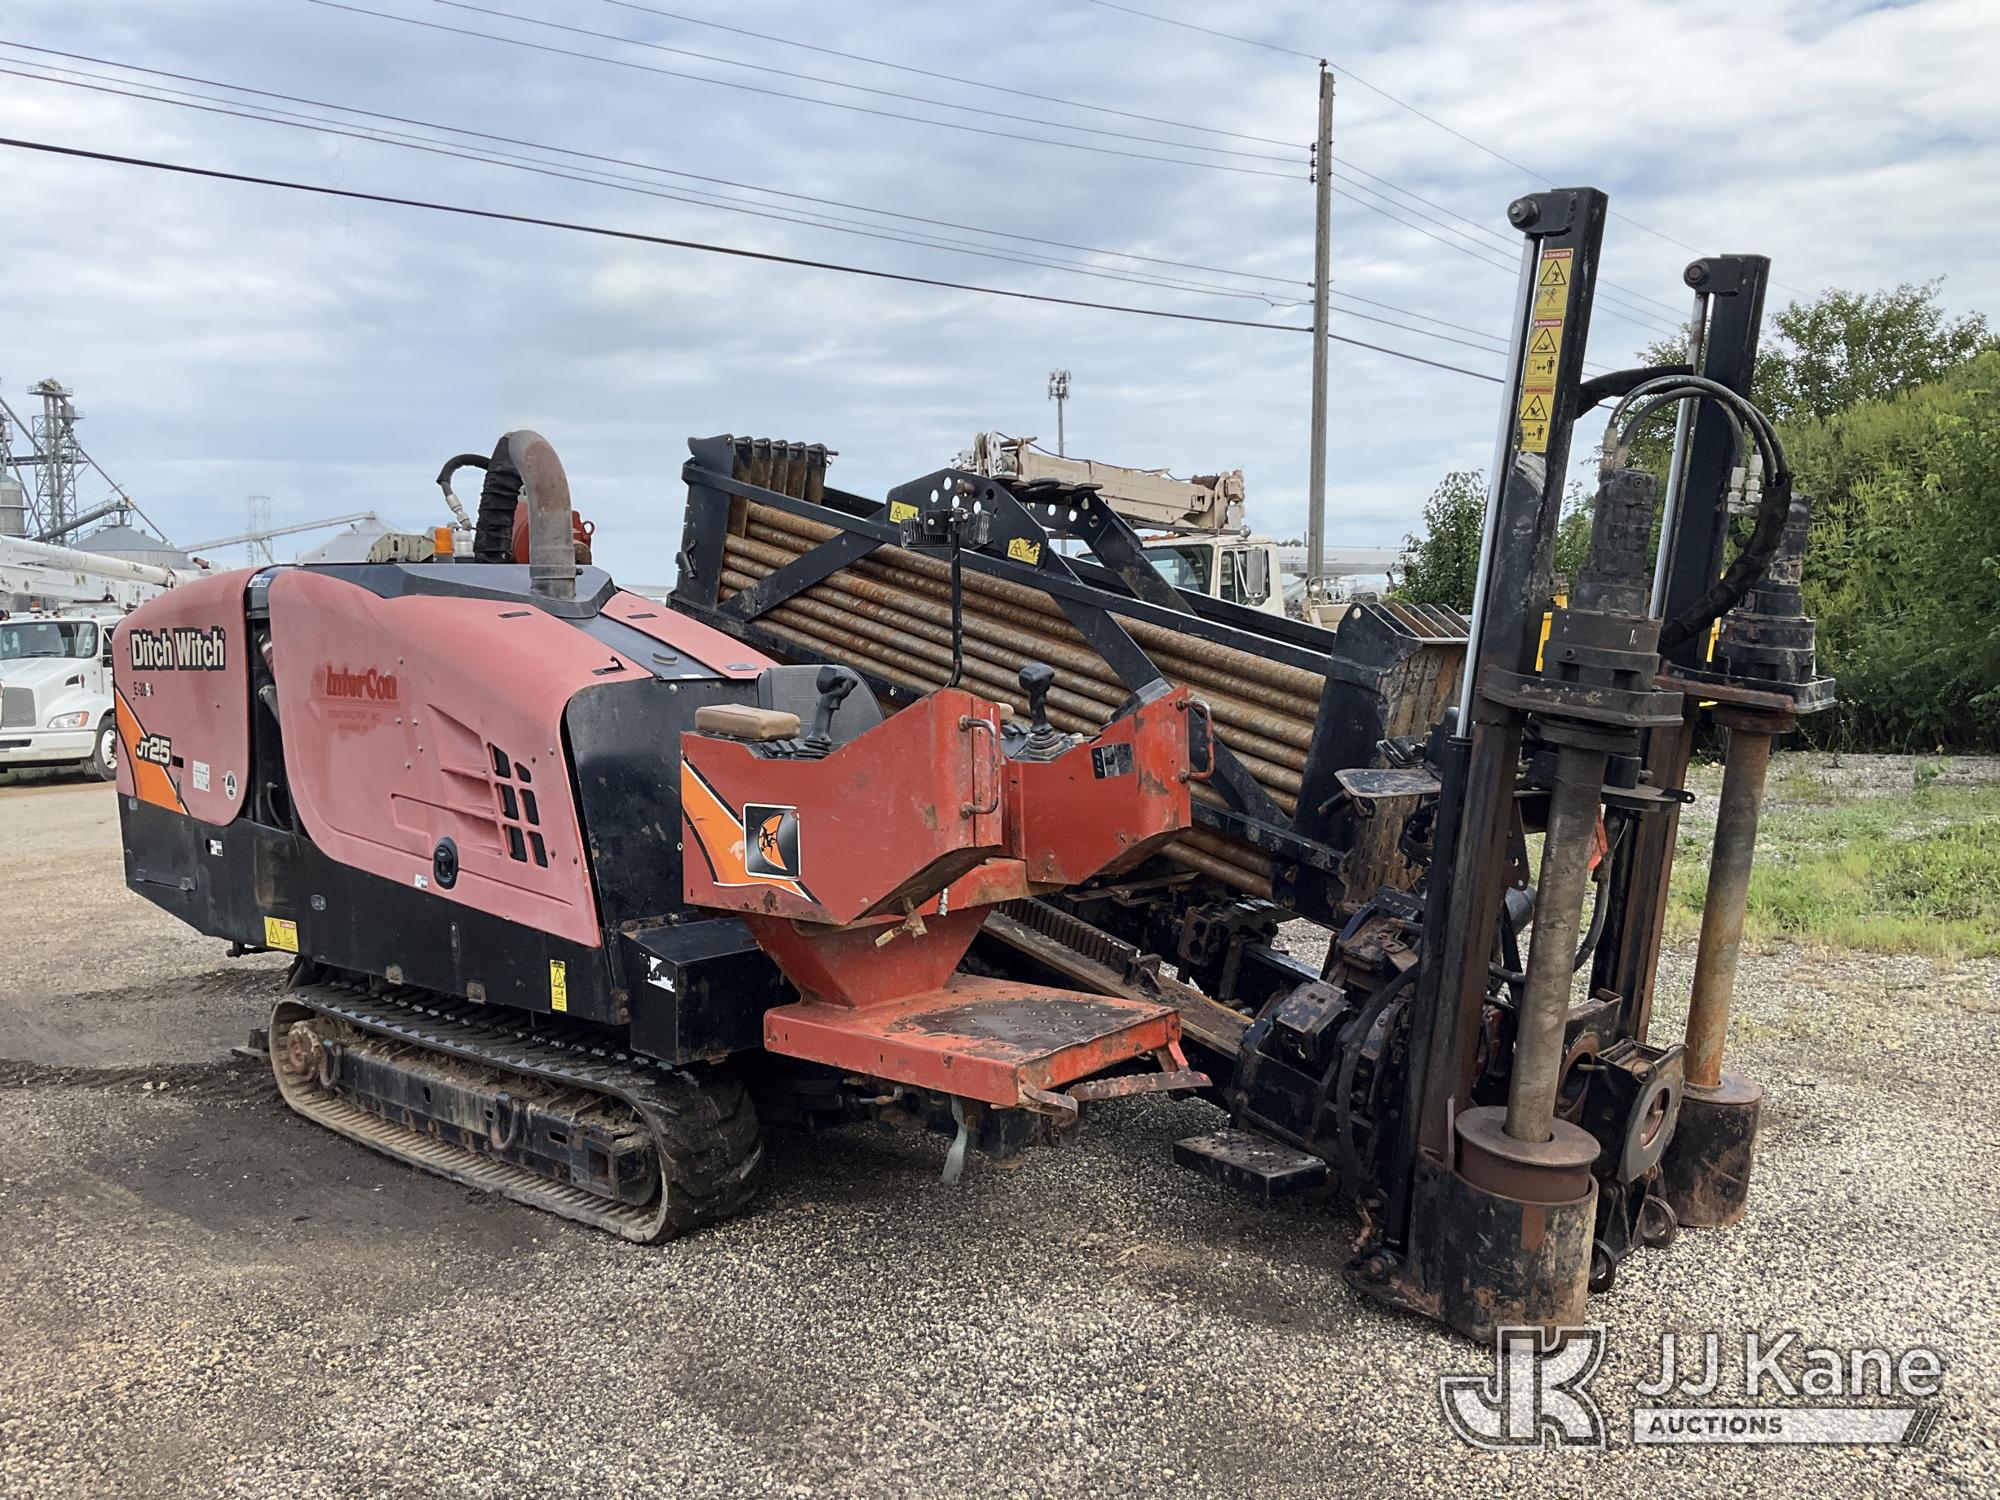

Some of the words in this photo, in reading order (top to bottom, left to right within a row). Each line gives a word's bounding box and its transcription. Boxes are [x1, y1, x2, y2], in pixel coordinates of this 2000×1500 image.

[131, 630, 174, 667] Ditch
[174, 627, 225, 668] Witch
[136, 735, 171, 764] JT25
